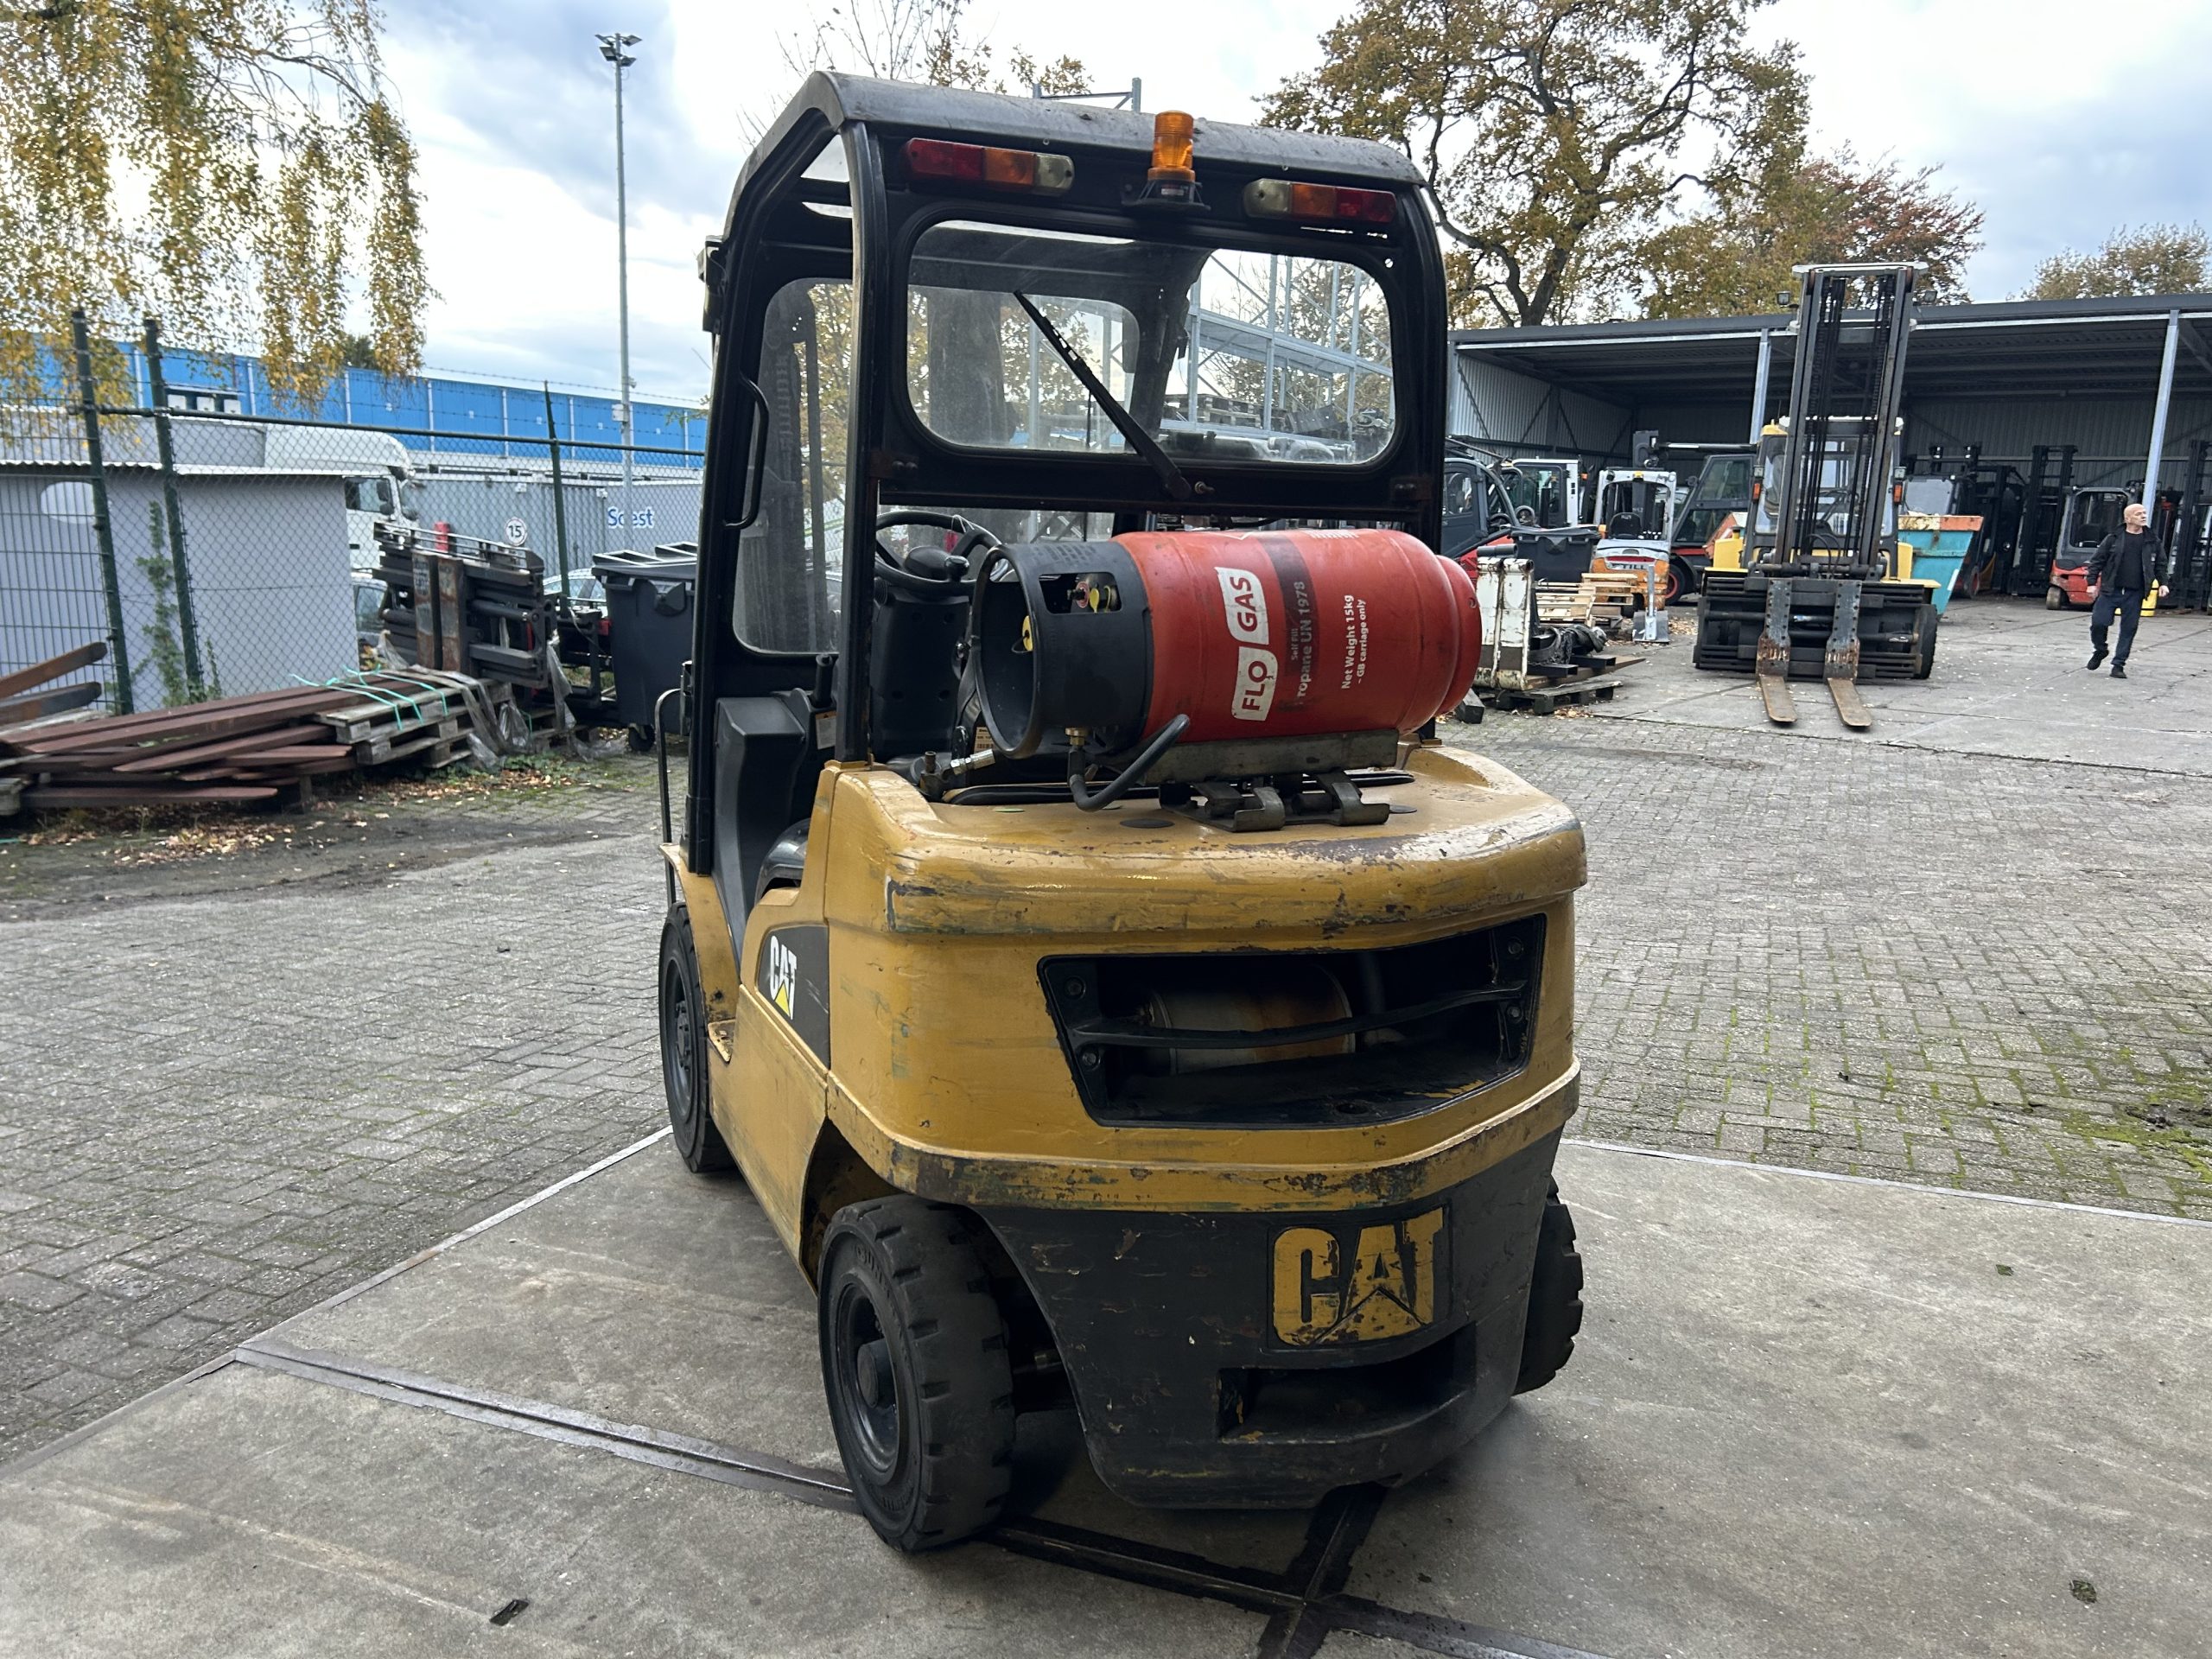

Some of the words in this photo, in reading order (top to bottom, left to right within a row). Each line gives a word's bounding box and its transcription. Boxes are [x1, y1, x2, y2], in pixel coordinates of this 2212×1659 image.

[507, 524, 522, 538] 15
[1230, 576, 1258, 632] GAS
[1294, 581, 1311, 614] 1978
[1343, 594, 1354, 622] 15kg
[1357, 599, 1366, 620] only
[1300, 619, 1313, 643] UN
[1344, 626, 1357, 667] Weight
[1359, 623, 1369, 662] carriage
[1242, 660, 1268, 711] FLO
[1297, 645, 1312, 704] ropane
[1341, 670, 1352, 690] Net
[770, 935, 797, 1020] CAT
[1273, 1207, 1443, 1346] CAT
